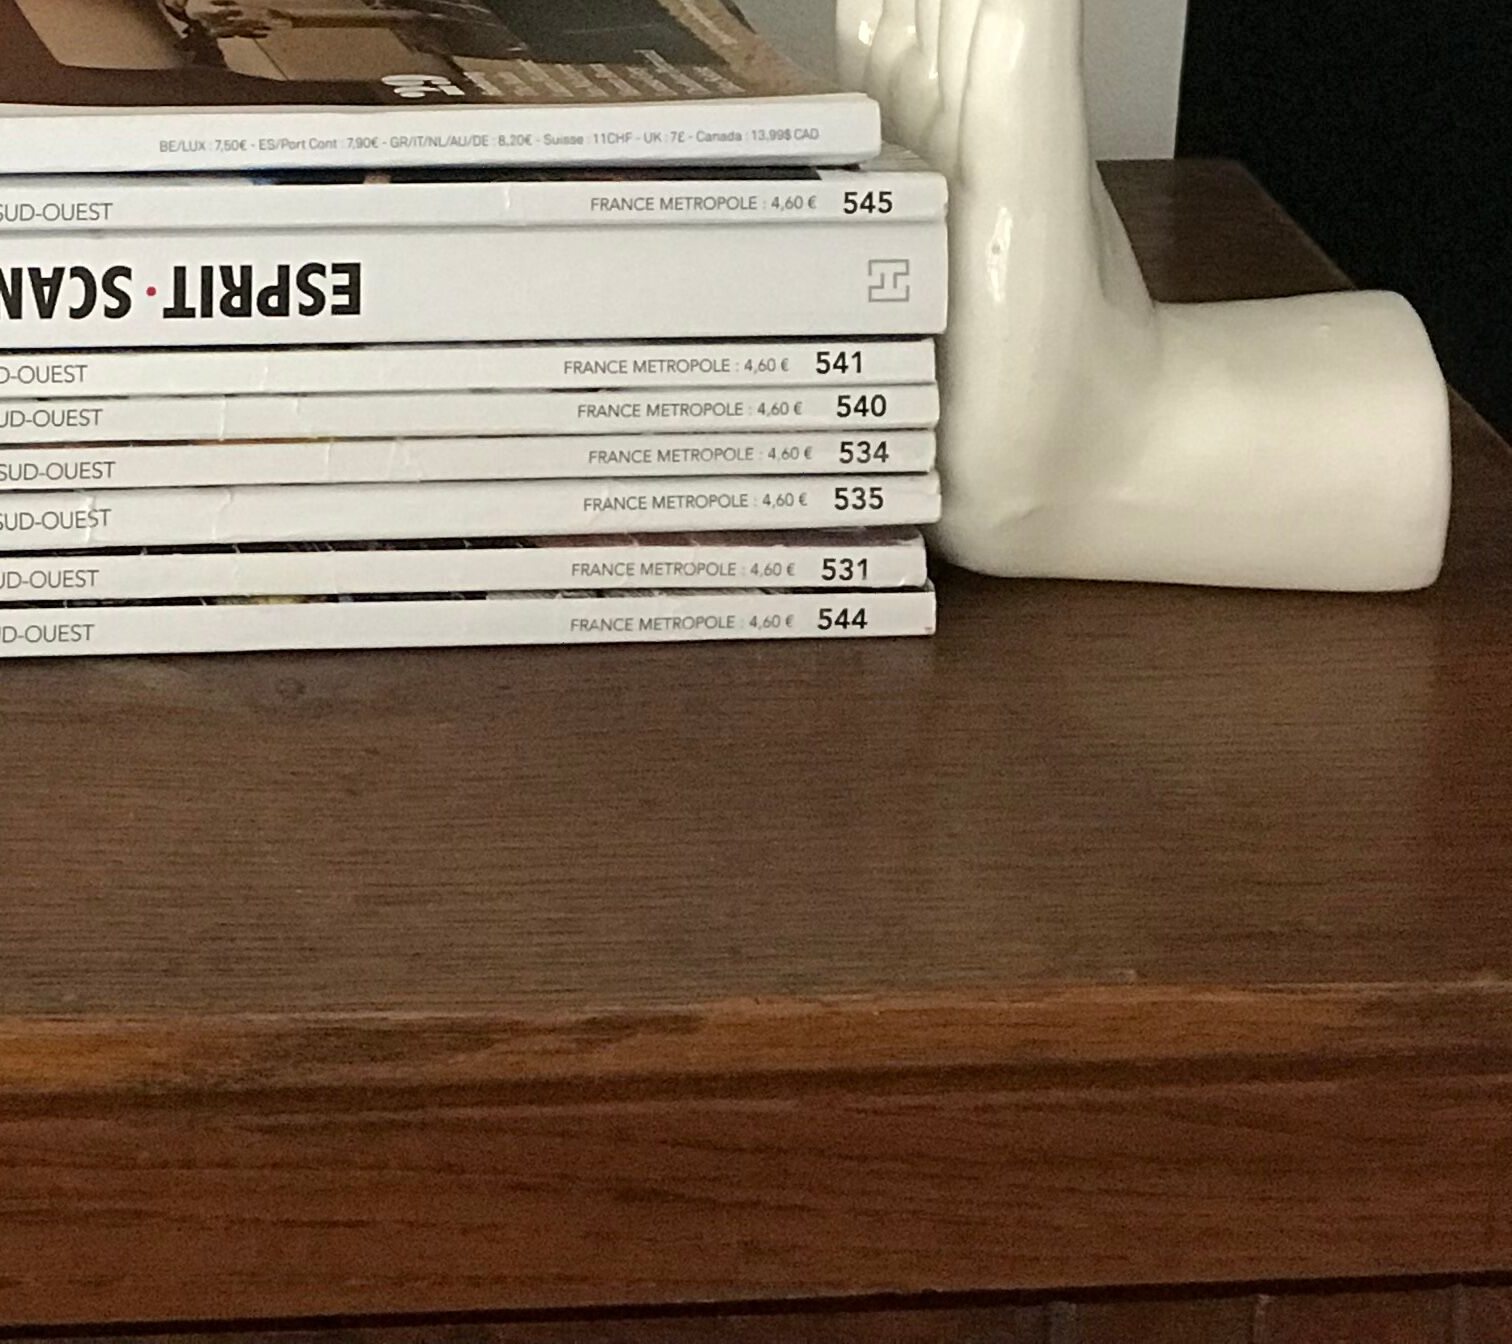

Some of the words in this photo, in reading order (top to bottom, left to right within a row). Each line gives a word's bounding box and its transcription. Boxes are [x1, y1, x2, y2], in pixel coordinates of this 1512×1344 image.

[644, 131, 662, 144] UK
[794, 128, 820, 140] CAD
[590, 197, 655, 211] FRANCE
[660, 196, 757, 210] METROPOLE
[771, 196, 804, 211] 4,60
[843, 191, 893, 214] 545
[163, 262, 361, 318] ESPRIT
[564, 360, 627, 374] FRANCE
[633, 359, 730, 373] METROPOLE
[744, 359, 776, 373] 4,60
[816, 351, 863, 374] 541
[577, 404, 640, 418] FRANCE
[646, 403, 743, 417] METROPOLE
[757, 402, 789, 416] 4,60
[837, 395, 887, 417] 540
[588, 450, 651, 464] FRANCE
[657, 448, 754, 463] METROPOLE
[767, 447, 800, 462] 4,60
[839, 441, 889, 463] 534
[583, 497, 647, 511] FRANCE
[652, 494, 748, 509] METROPOLE
[762, 493, 794, 508] 4,60
[834, 487, 884, 510] 535
[571, 562, 635, 577] FRANCE
[640, 562, 736, 576] METROPOLE
[750, 562, 783, 577] 4,60
[821, 558, 868, 581] 531
[571, 618, 633, 632] FRANCE
[638, 616, 735, 630] METROPOLE
[749, 615, 781, 629] 4,60
[817, 609, 868, 630] 544
